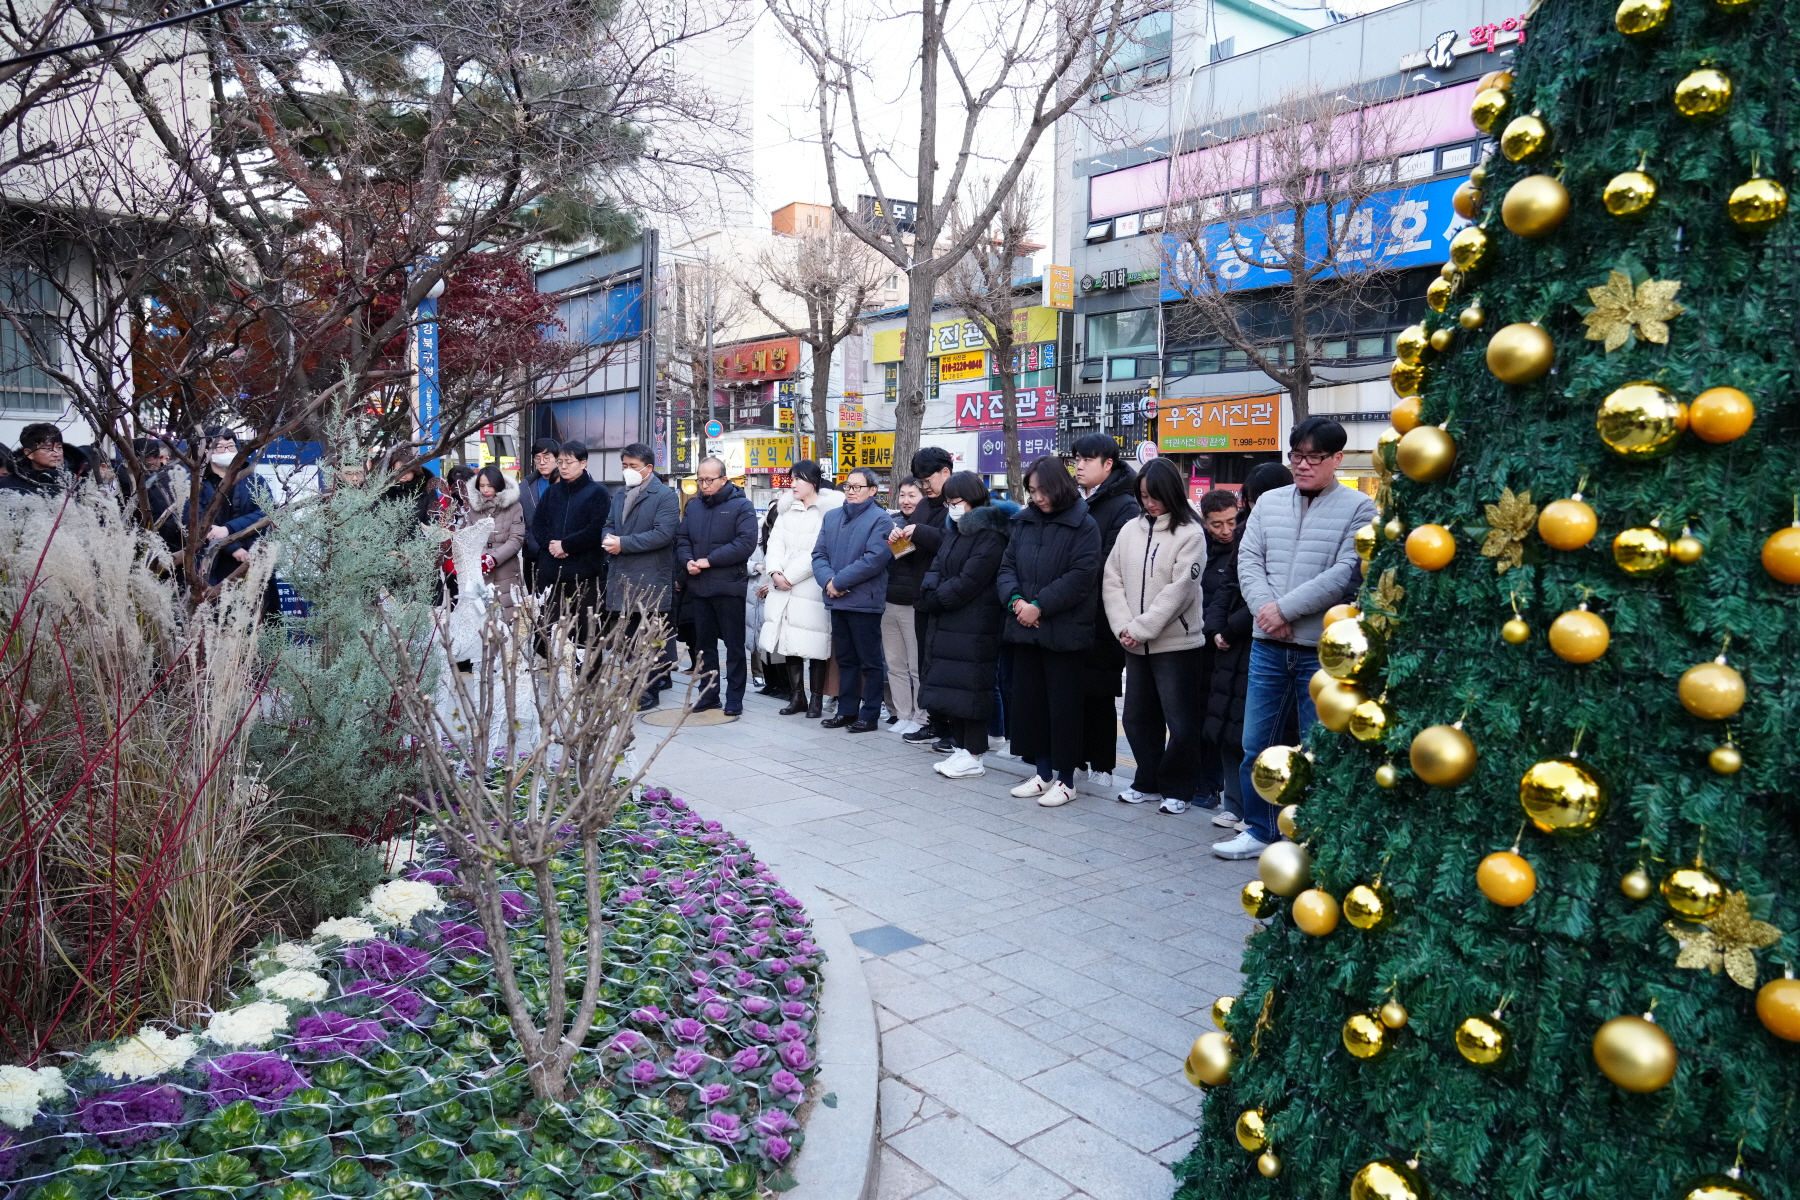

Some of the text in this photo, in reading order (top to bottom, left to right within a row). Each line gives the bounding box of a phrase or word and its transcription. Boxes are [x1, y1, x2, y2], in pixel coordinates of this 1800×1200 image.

[1053, 281, 1071, 293] 사진
[1101, 268, 1127, 290] 최미화
[735, 347, 788, 374] 노래방
[1165, 405, 1205, 429] 우정
[1208, 402, 1273, 427] 사진관
[840, 431, 858, 468] 변호사
[862, 436, 877, 445] 변호사
[1025, 439, 1054, 455] 법무사
[1232, 438, 1276, 449] T.998-5710
[861, 448, 895, 466] 법률사무
